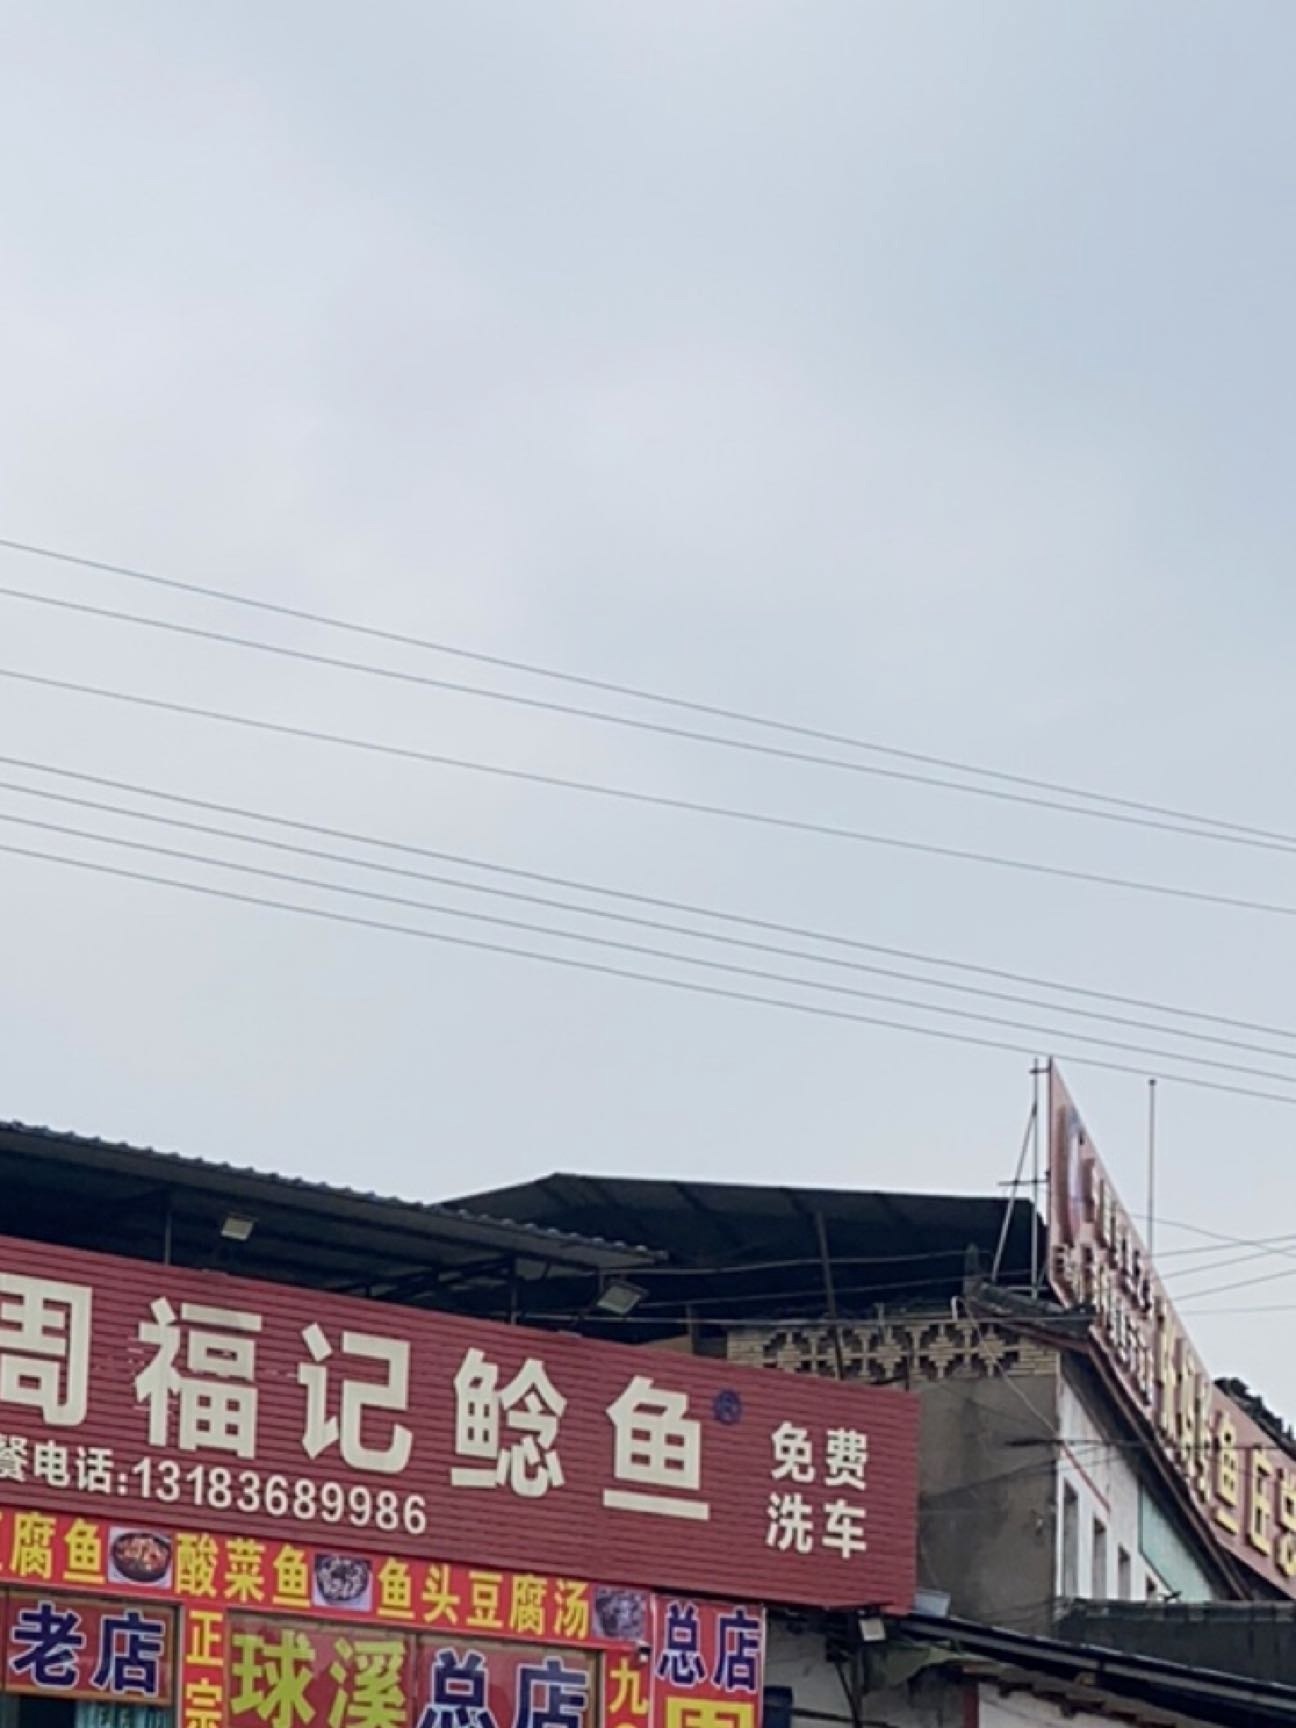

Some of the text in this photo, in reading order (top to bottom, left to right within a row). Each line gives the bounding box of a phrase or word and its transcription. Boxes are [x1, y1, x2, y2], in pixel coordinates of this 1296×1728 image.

[770, 1421, 869, 1491] 免费
[766, 1492, 868, 1559] 洗车
[175, 1533, 310, 1609] 酸菜鱼
[377, 1558, 590, 1641] 鱼头豆腐汤
[655, 1602, 760, 1693] 总店
